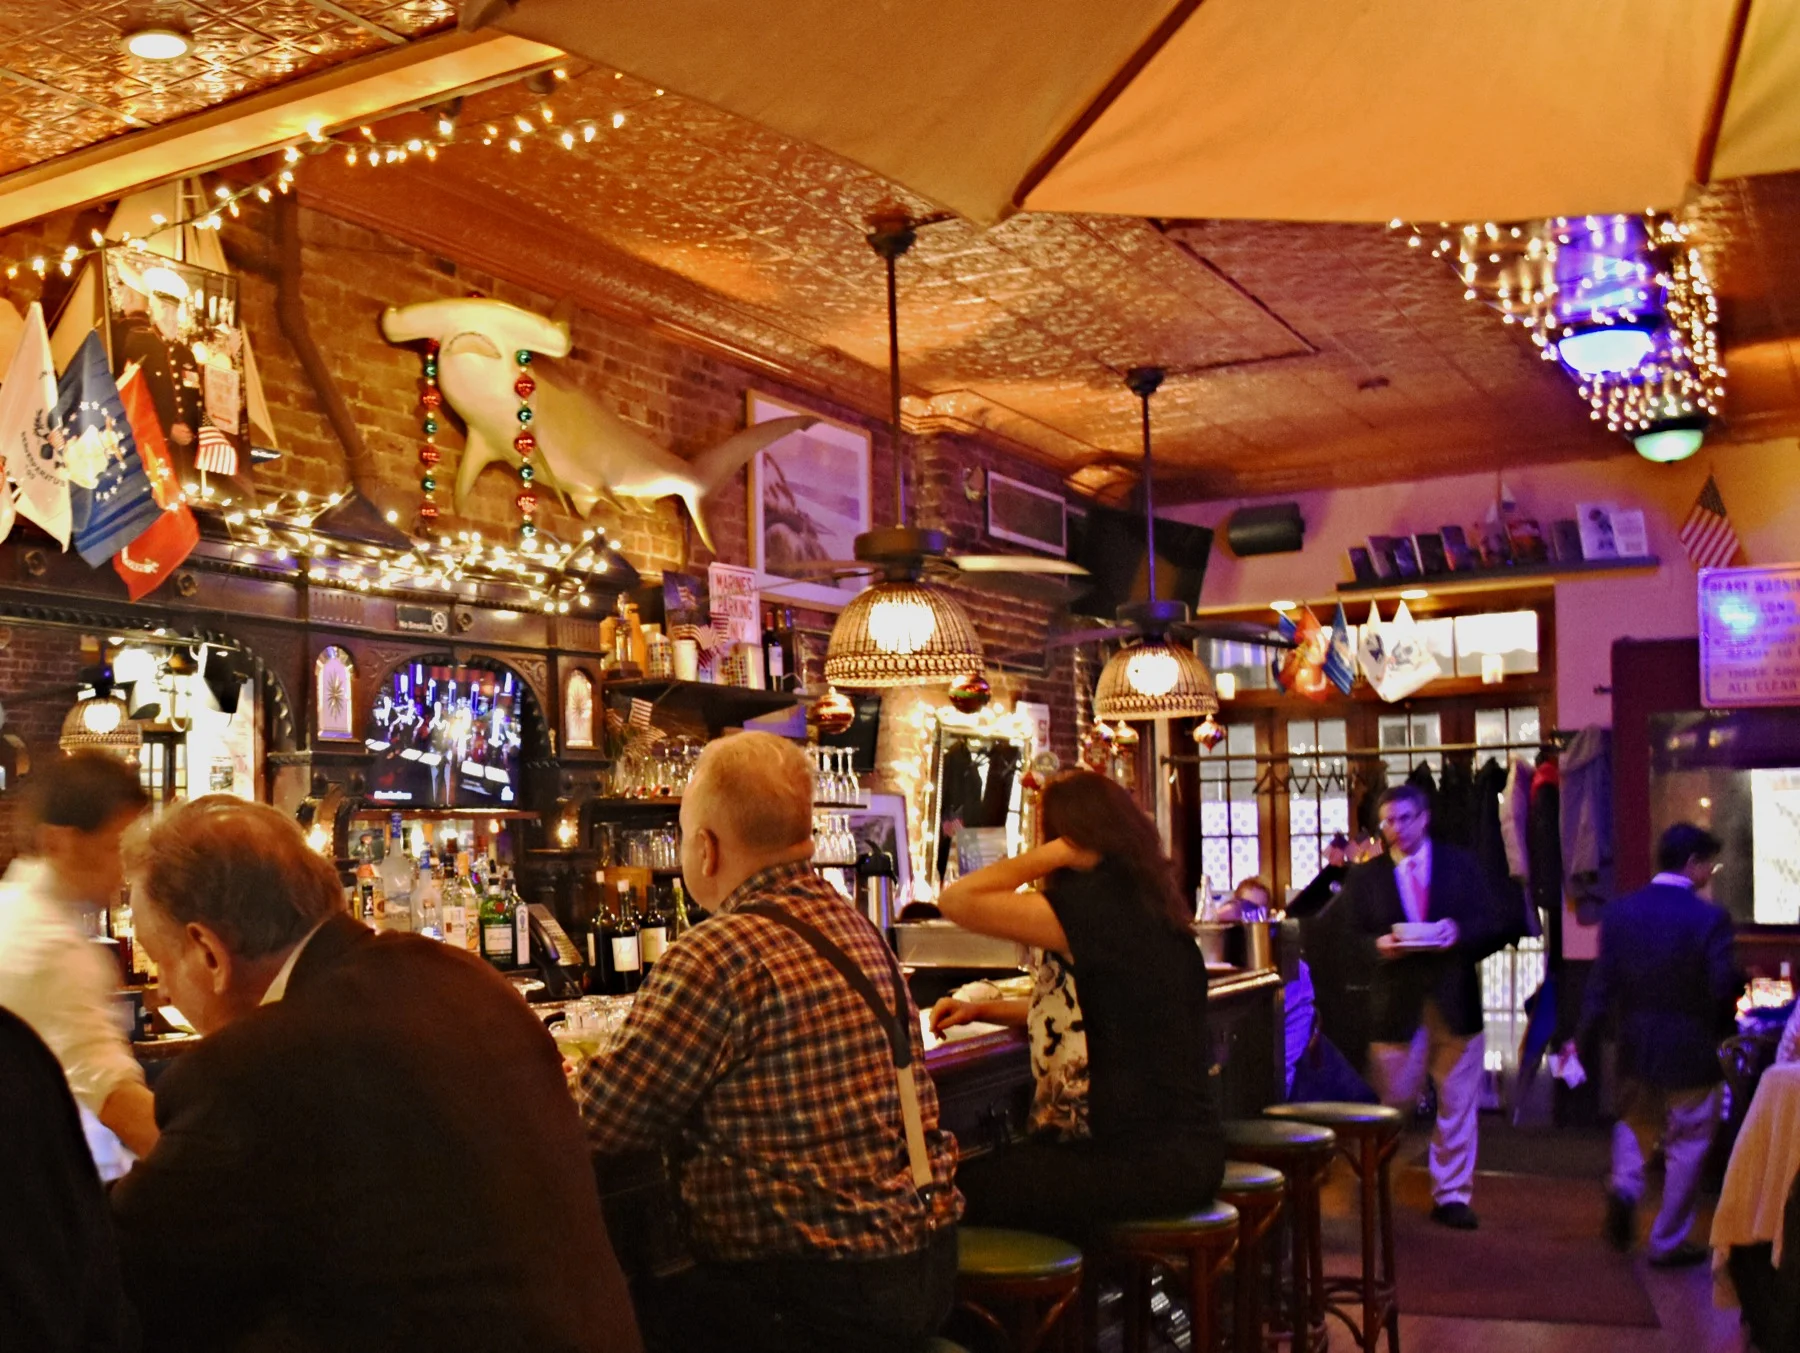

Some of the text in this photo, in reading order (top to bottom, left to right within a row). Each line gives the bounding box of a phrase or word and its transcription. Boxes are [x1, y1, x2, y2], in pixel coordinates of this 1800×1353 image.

[716, 572, 754, 597] MARINES
[1755, 578, 1800, 593] WARNIN
[398, 620, 433, 632] No Smoking
[1728, 679, 1798, 693] ALL CLEAR
